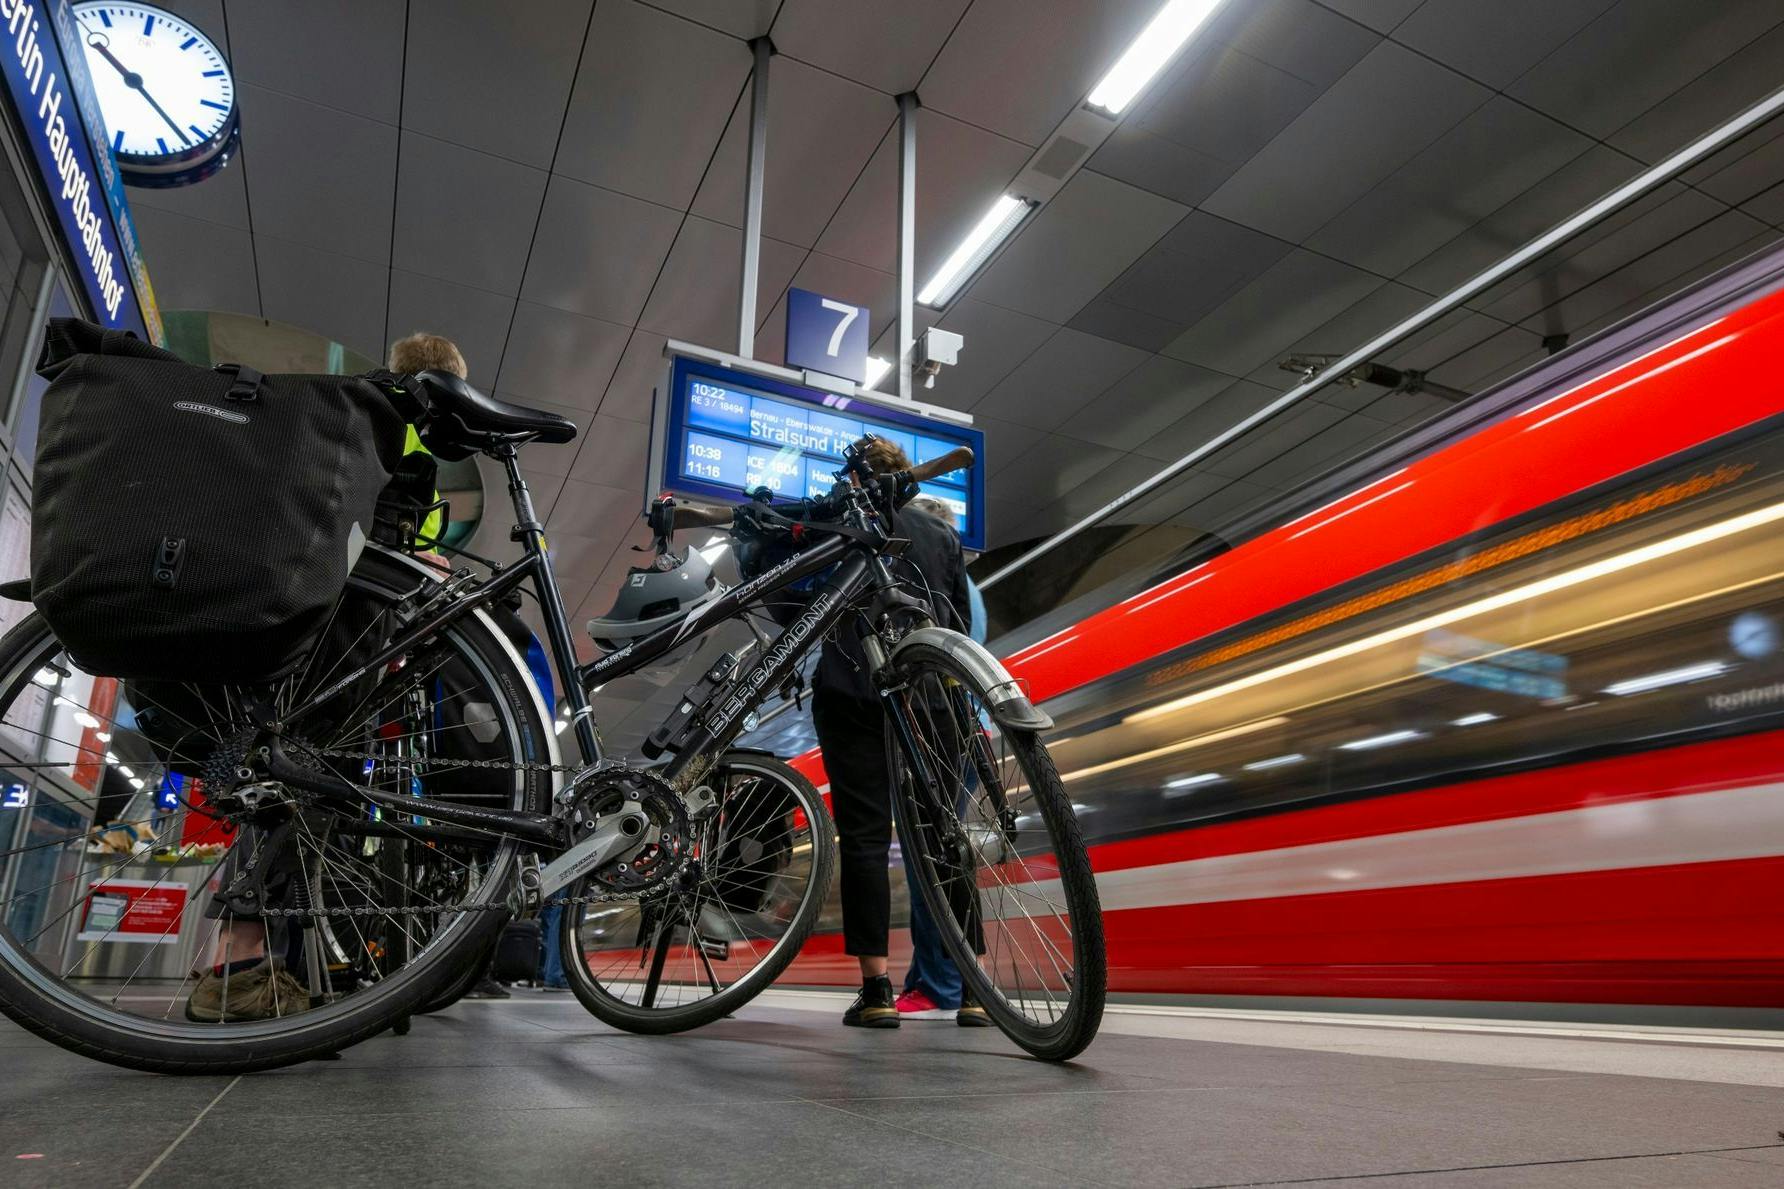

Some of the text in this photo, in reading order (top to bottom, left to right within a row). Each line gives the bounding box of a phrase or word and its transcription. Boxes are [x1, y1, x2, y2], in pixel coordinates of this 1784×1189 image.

[39, 73, 125, 320] Hauptbahnhof
[822, 298, 859, 357] 7
[691, 395, 702, 405] RE
[694, 383, 726, 400] 10:22
[750, 420, 828, 452] Stralsund
[688, 443, 722, 461] 10:38
[747, 455, 765, 470] ICE
[811, 470, 838, 485] Ham
[705, 592, 833, 739] BERGAMONT
[501, 673, 528, 724] SCHWALBE
